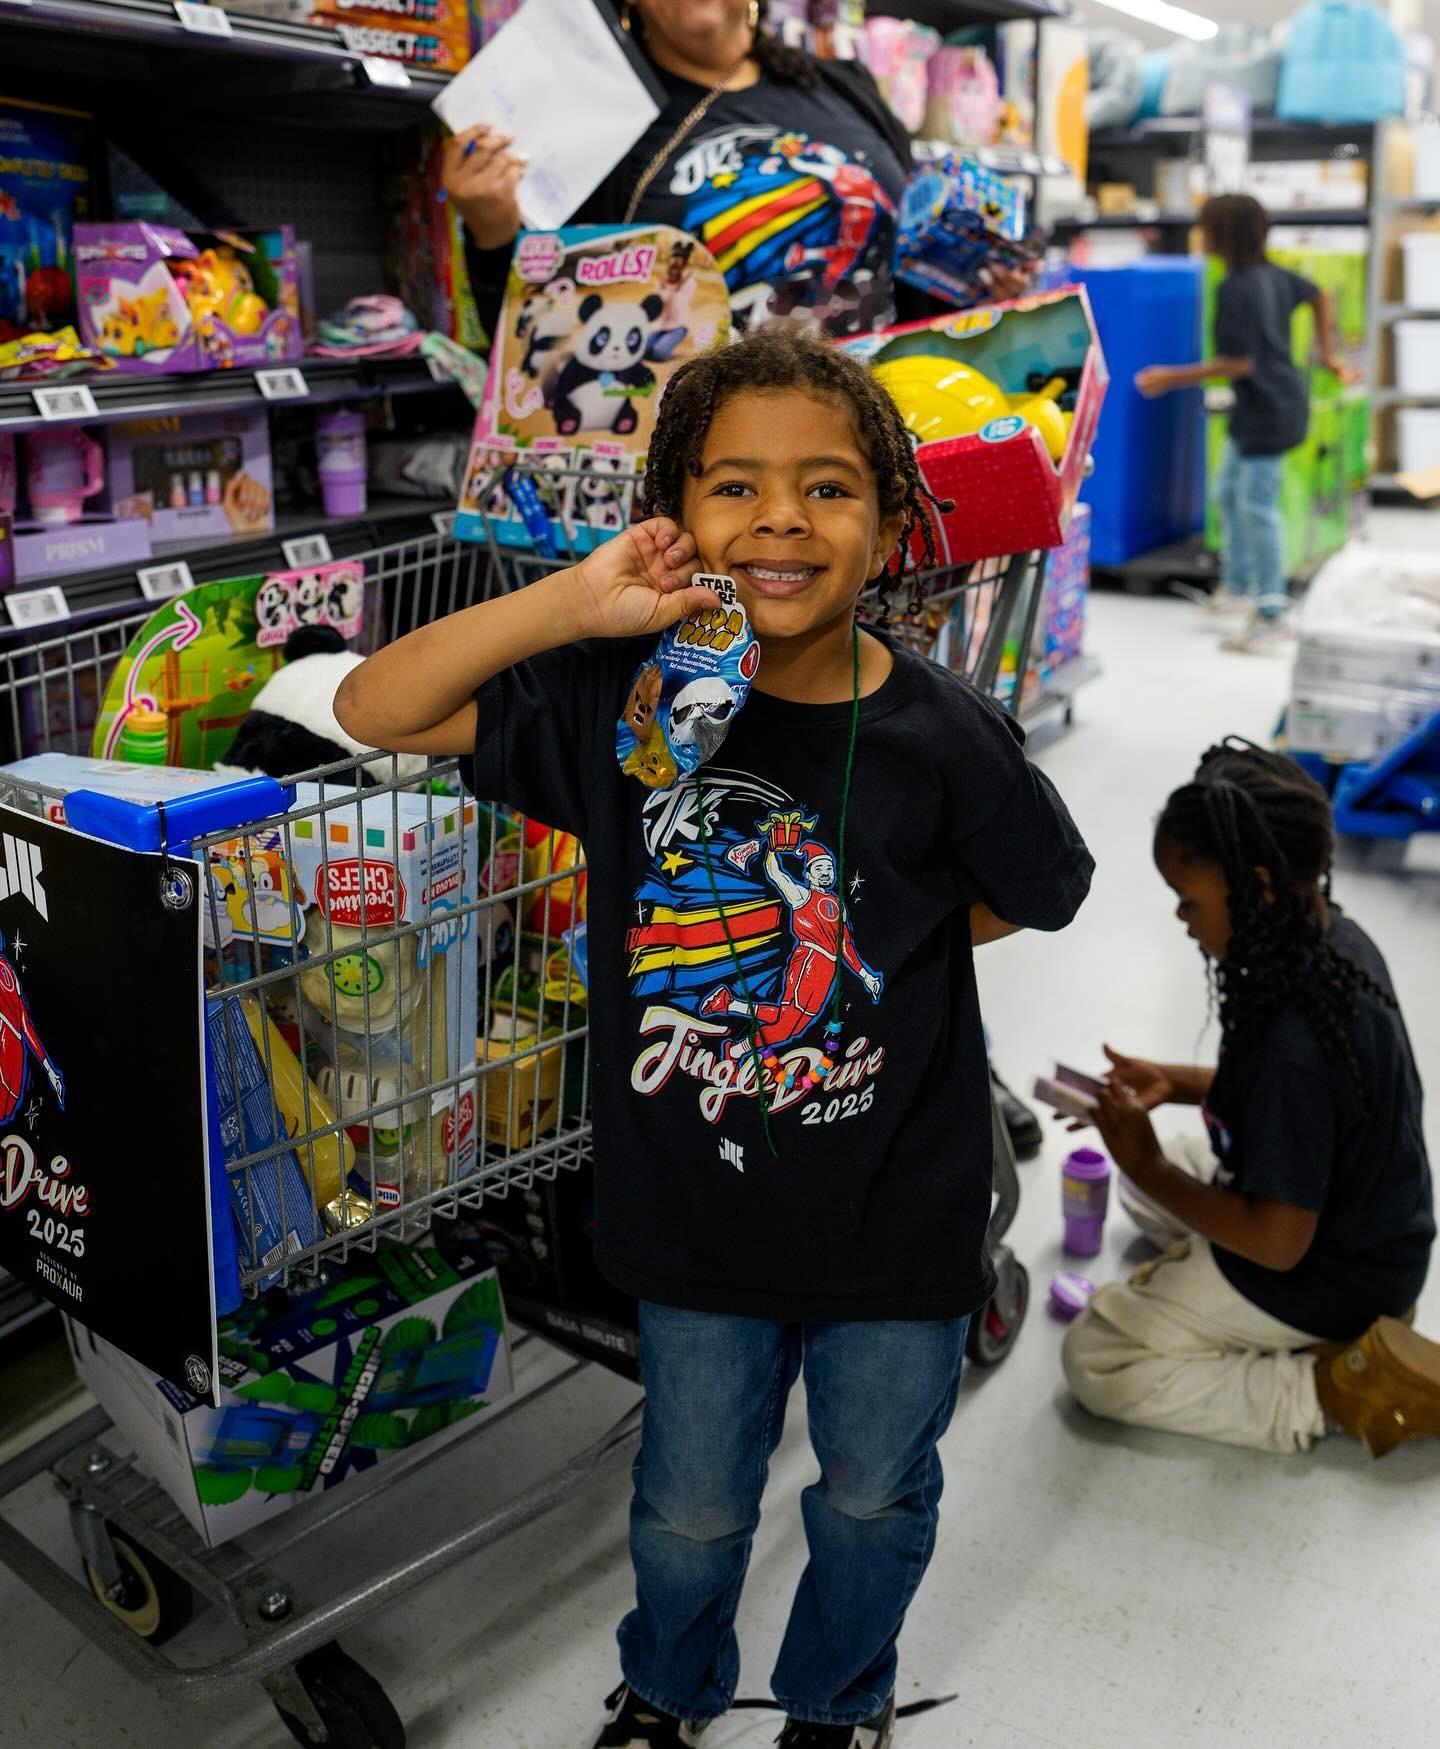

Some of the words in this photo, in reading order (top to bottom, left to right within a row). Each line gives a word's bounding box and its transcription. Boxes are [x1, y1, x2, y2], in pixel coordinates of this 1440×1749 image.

[579, 249, 655, 280] ROLLS!
[695, 577, 736, 594] STAR
[327, 867, 388, 891] CHEFS
[631, 1006, 777, 1123] Jingle
[801, 1084, 875, 1125] 2025
[0, 1134, 88, 1213] Drive
[377, 1190, 399, 1203] little
[26, 1208, 86, 1257] 2025
[36, 1258, 83, 1303] PROXAUR
